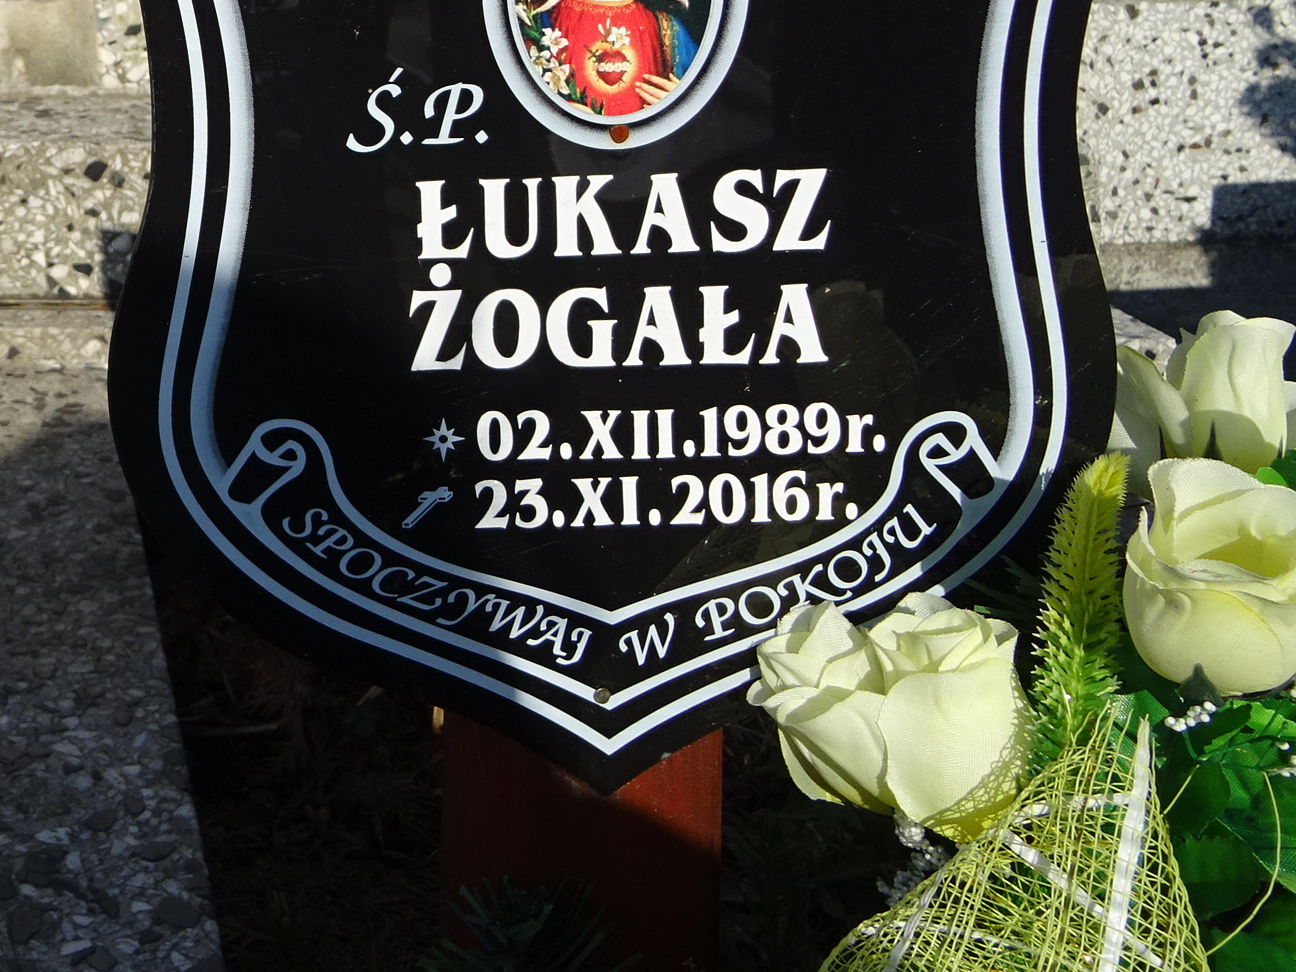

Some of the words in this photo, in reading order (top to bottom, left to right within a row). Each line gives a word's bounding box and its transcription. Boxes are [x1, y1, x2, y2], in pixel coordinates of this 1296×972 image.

[345, 67, 490, 153] Ś.P.
[415, 167, 833, 260] ŁUKASZ
[407, 262, 829, 372] ŻOGAŁA
[475, 402, 887, 462] 02.XII.1989r.
[474, 469, 860, 530] 23.XI.2016r.
[281, 507, 593, 666] SPOCZYWAJ
[617, 611, 676, 667] W
[694, 503, 938, 642] POKOJU
